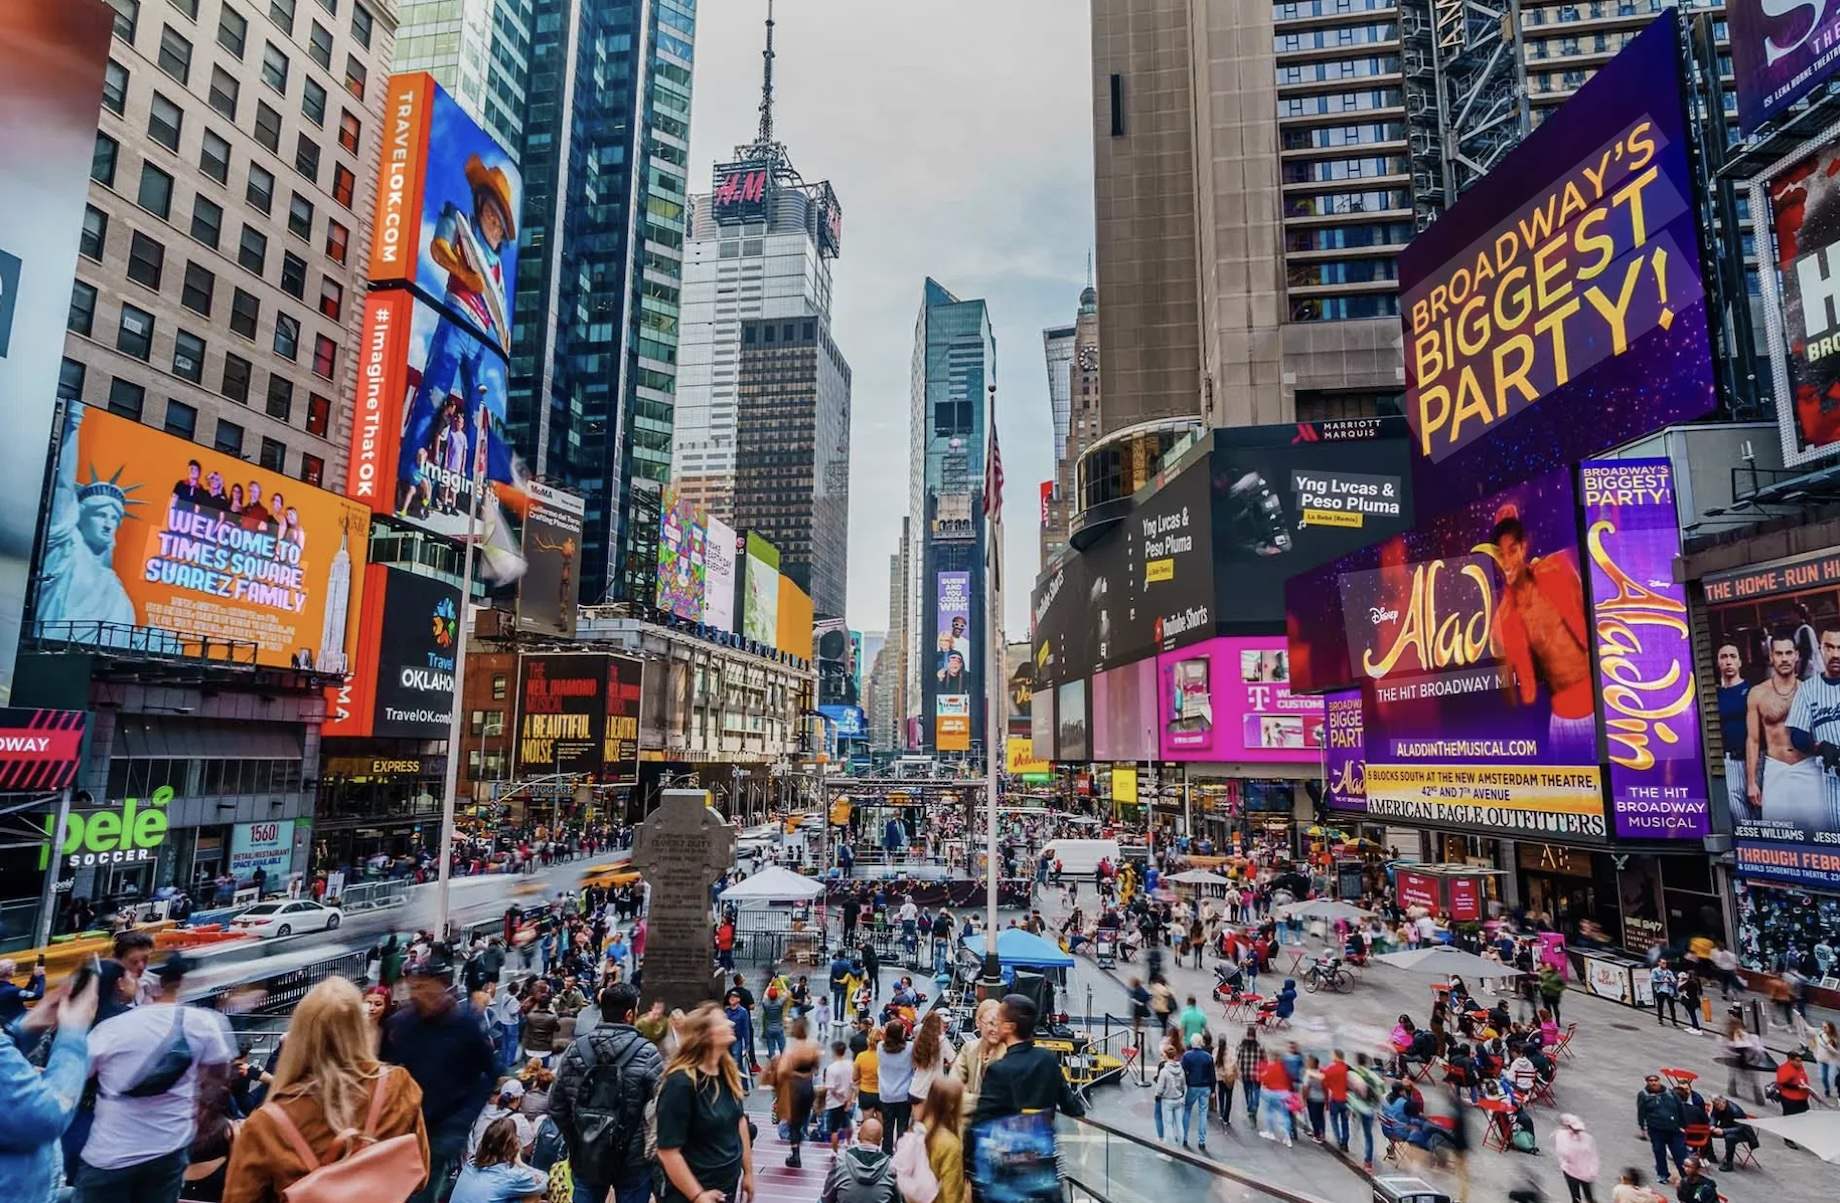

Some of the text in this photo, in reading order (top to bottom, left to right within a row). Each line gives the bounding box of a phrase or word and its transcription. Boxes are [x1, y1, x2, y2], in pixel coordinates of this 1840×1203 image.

[1774, 83, 1791, 100] LENA
[382, 90, 413, 263] TRAVELOK.COM
[1412, 121, 1655, 336] BROADWAY'S
[1415, 165, 1658, 389] BIGGEST
[1418, 246, 1675, 457] PARTY!
[1323, 419, 1381, 430] MARRIOTT
[1324, 429, 1375, 439] MARQUIS
[1583, 464, 1668, 477] BROADWAY'S
[530, 484, 553, 499] MoMA
[1296, 476, 1394, 497] Yng Lvcas &
[1584, 474, 1668, 491] BIGGEST
[1301, 493, 1400, 514] Peso Pluma
[1586, 488, 1672, 507] PARTY!
[1143, 506, 1189, 539] Yng Lvcas &
[168, 508, 301, 565] WELCOME TO
[1145, 534, 1192, 559] Peso Pluma
[158, 531, 304, 589] TIMES SQUARE
[145, 557, 307, 613] SUAREZ FAMILY
[1705, 582, 1732, 600] THE
[1735, 564, 1819, 596] HOME-RUN
[1163, 604, 1208, 638] YouTube Shorts
[428, 651, 453, 671] Travel
[529, 662, 545, 679] THE
[1377, 681, 1397, 702] THE
[1399, 680, 1416, 700] HIT
[1420, 676, 1490, 698] BROADWAY
[523, 714, 591, 739] A BEAUTIFUL
[521, 739, 554, 763] NOISE
[604, 739, 620, 762] NOISE
[373, 760, 420, 773] EXPRESS
[1367, 769, 1597, 791] 5 BLOCKS SOUTH AT THE NEW AMSTERDAM THEATRE,
[1439, 787, 1457, 798] AND
[1473, 788, 1510, 800] AVENUE
[1629, 787, 1688, 798] THE HIT
[1368, 798, 1604, 836] AMERICAN EAGLE OUTFITTERS
[1616, 801, 1706, 815] BROADWAY
[39, 786, 174, 871] pelé
[1628, 816, 1697, 829] MUSICAL
[1734, 826, 1759, 838] JESSE
[1760, 828, 1804, 841] WILLIAMS
[69, 849, 148, 867] SOCCER
[233, 857, 282, 869] SPACE AVAILABLE
[1736, 847, 1798, 867] THROUGH
[1744, 864, 1765, 872] GERALD
[1766, 867, 1801, 877] SCHOENFELD
